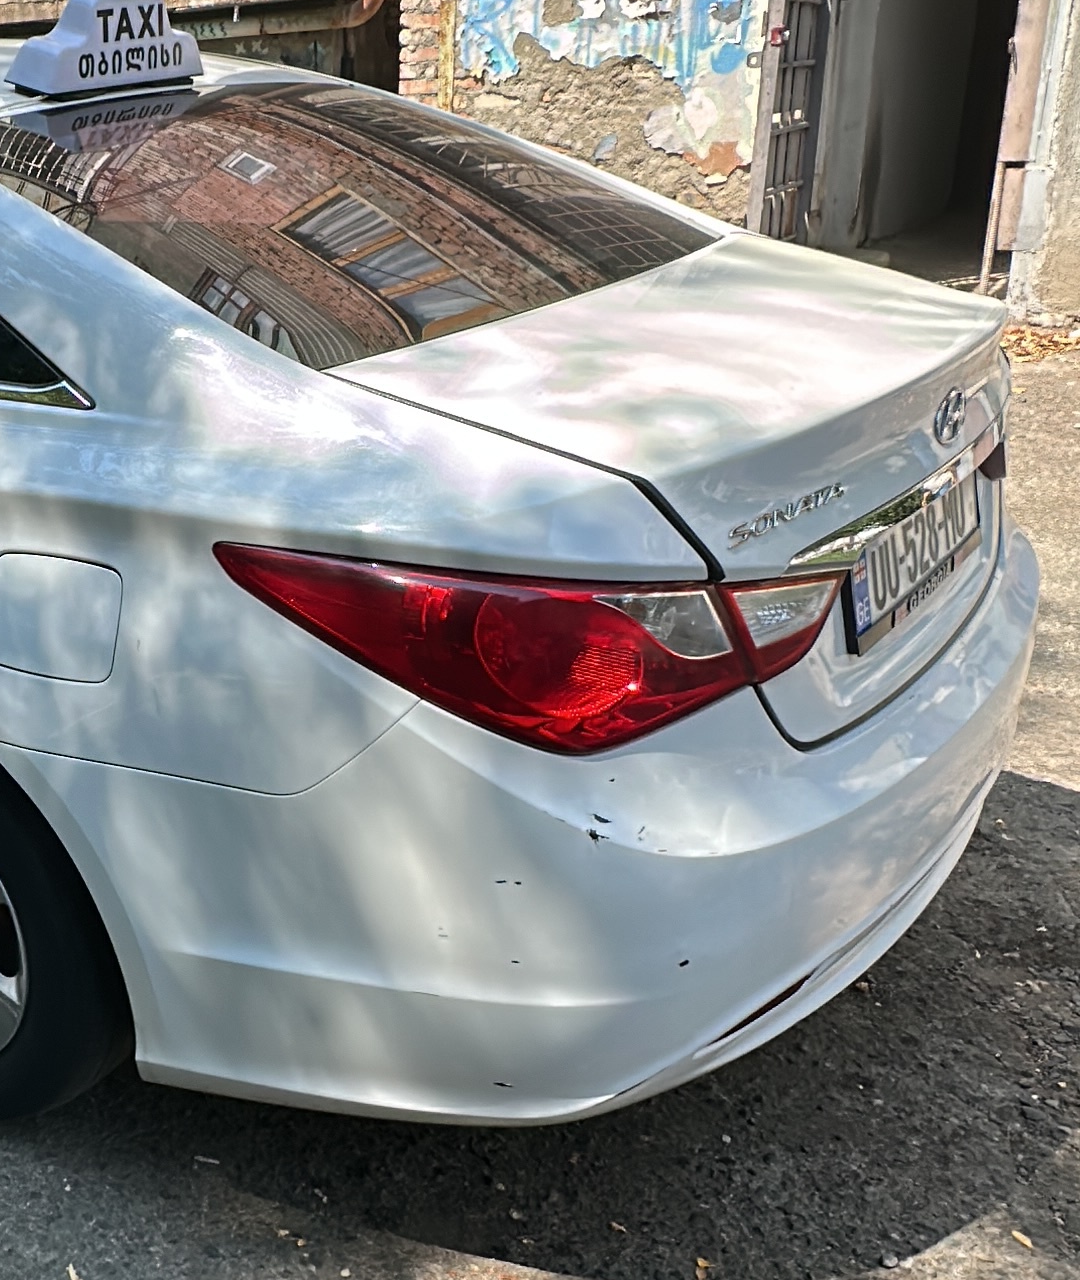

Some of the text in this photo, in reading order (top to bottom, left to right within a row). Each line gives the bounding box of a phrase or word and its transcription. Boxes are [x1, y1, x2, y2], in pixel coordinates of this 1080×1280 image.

[97, 3, 164, 43] TAXI
[78, 41, 183, 79] თბილისი
[727, 482, 845, 550] SONATA
[856, 596, 870, 626] GE
